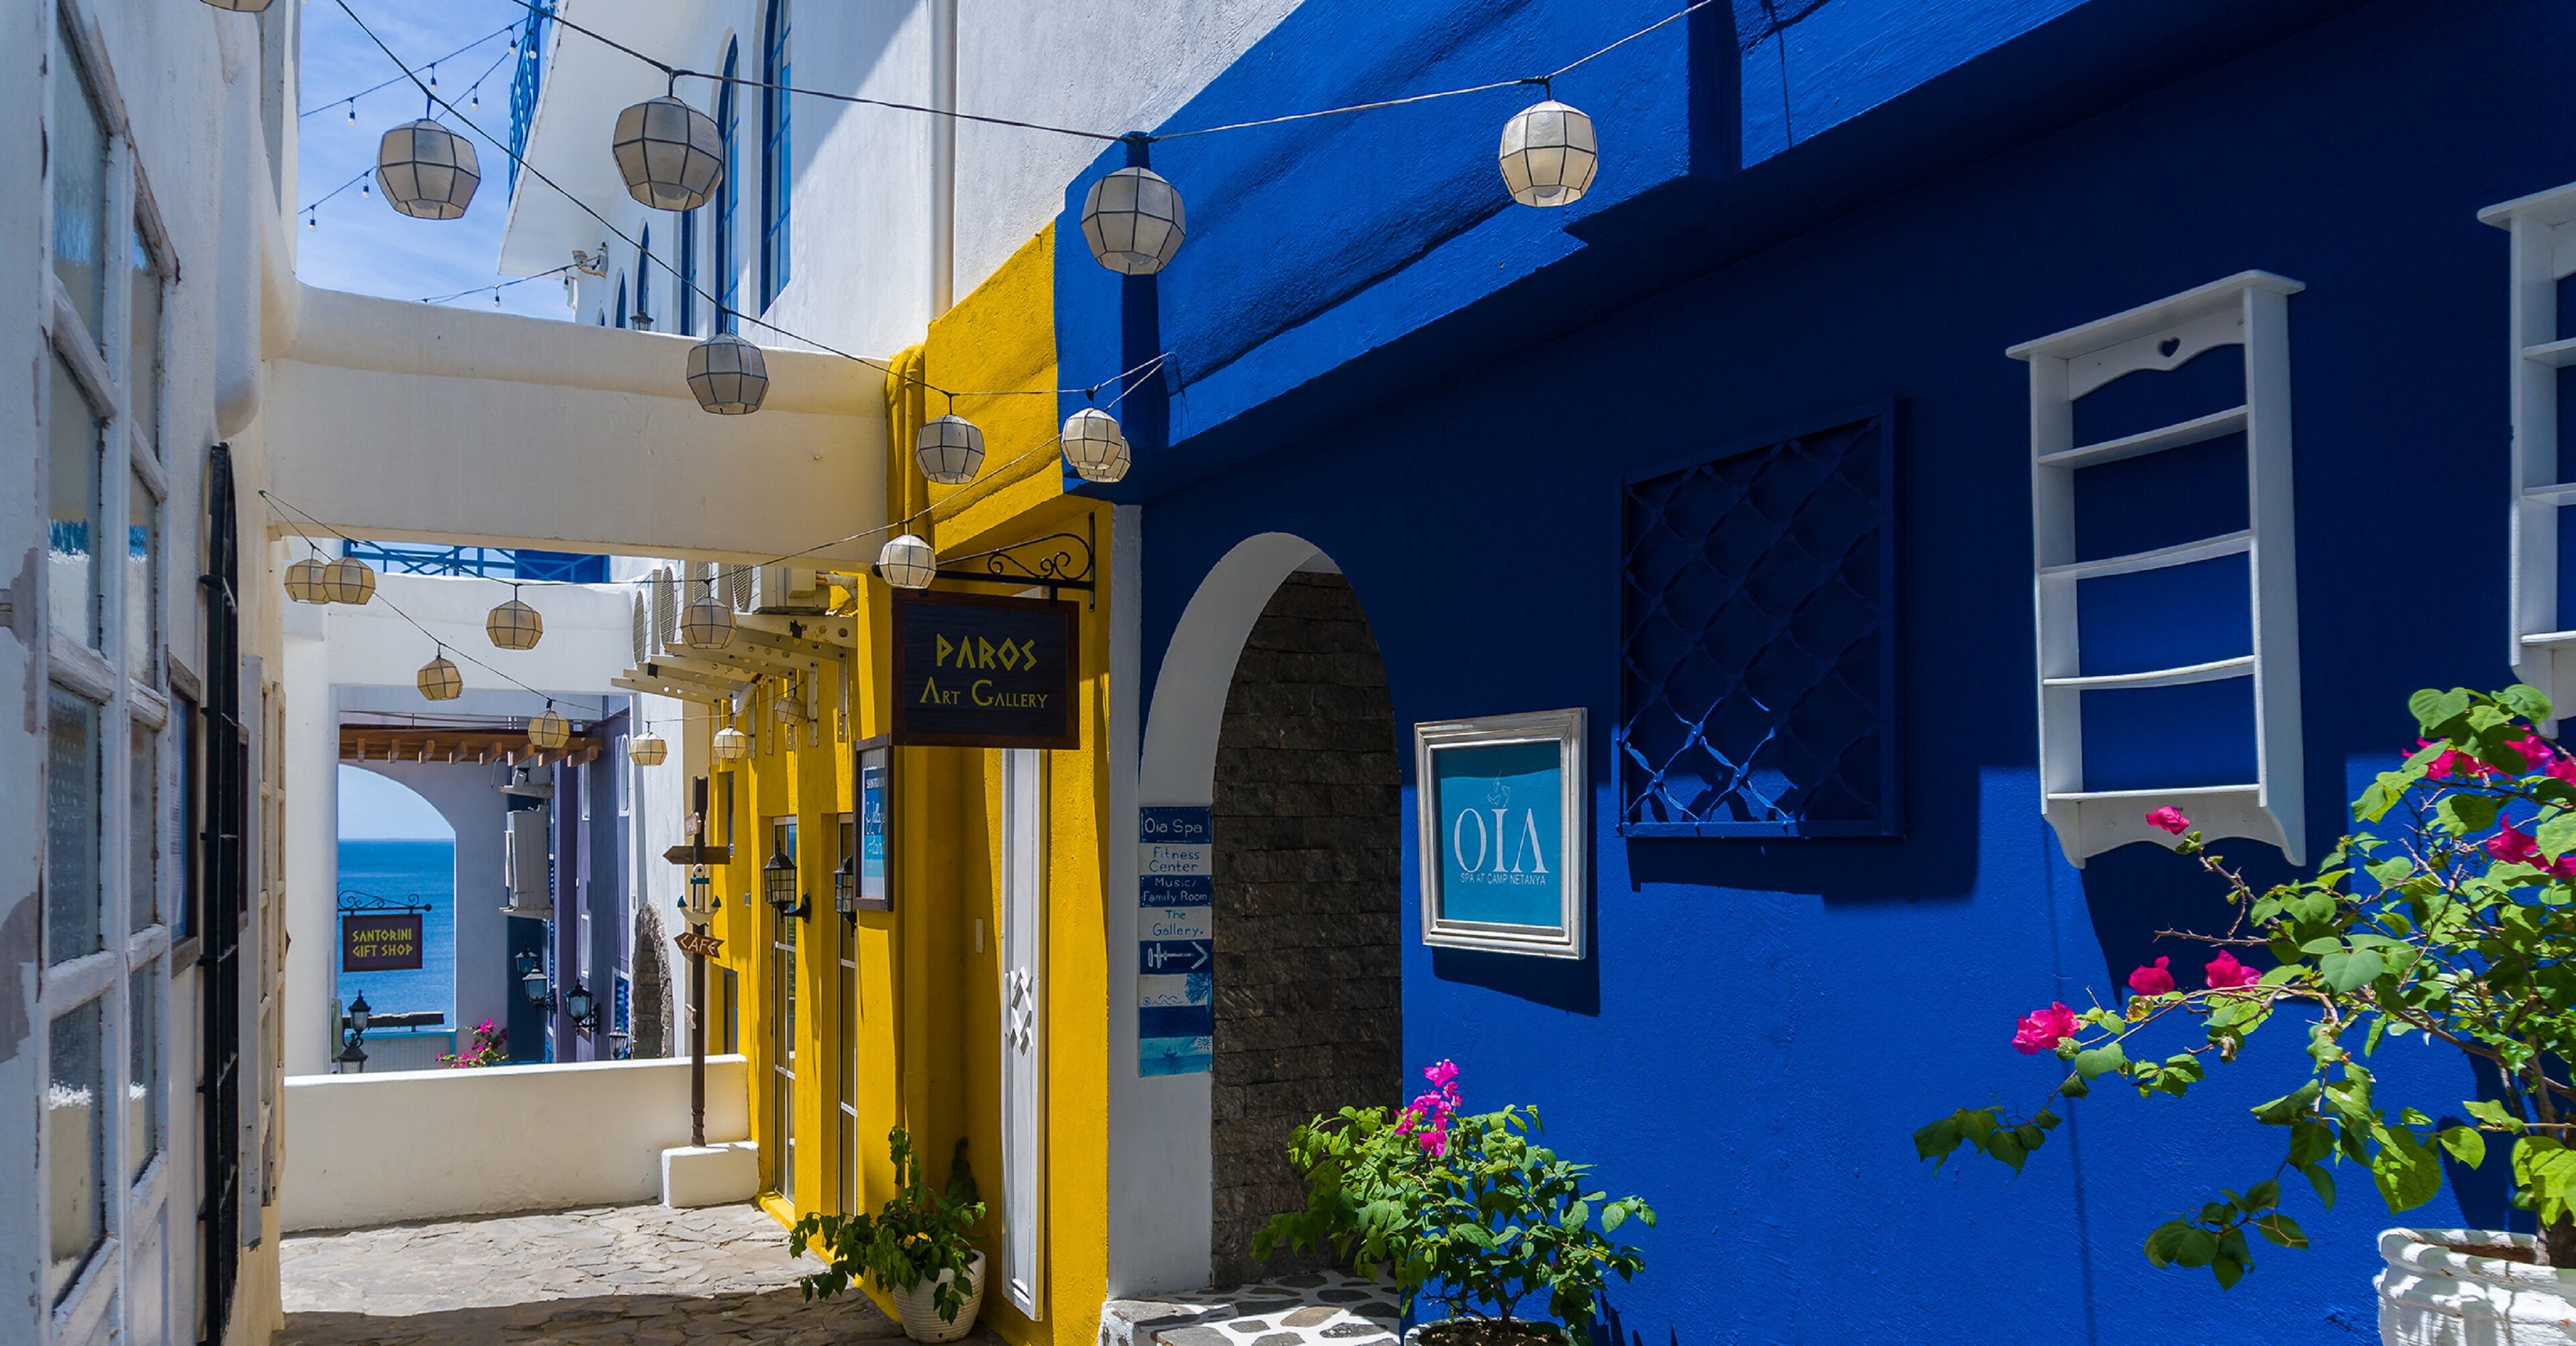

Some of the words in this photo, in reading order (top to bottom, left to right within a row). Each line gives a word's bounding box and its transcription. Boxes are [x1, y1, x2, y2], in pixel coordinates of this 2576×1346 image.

[936, 633, 1037, 671] PAROS
[1144, 817, 1168, 834] Oia
[1173, 818, 1203, 838] Spa
[1454, 807, 1550, 873] OIA
[1154, 846, 1200, 860] Fitness
[1149, 859, 1199, 873] Center
[1460, 873, 1475, 883] SPA
[1477, 873, 1485, 883] AT
[1487, 873, 1508, 885] CAMP
[1509, 875, 1546, 886] NETANYA
[1143, 891, 1177, 905] Family
[1181, 890, 1208, 901] Room
[1165, 909, 1187, 920] The
[352, 928, 413, 942] SANTORINI
[352, 944, 378, 958] GIFT
[380, 944, 413, 956] SHOP
[680, 934, 719, 956] CAFE
